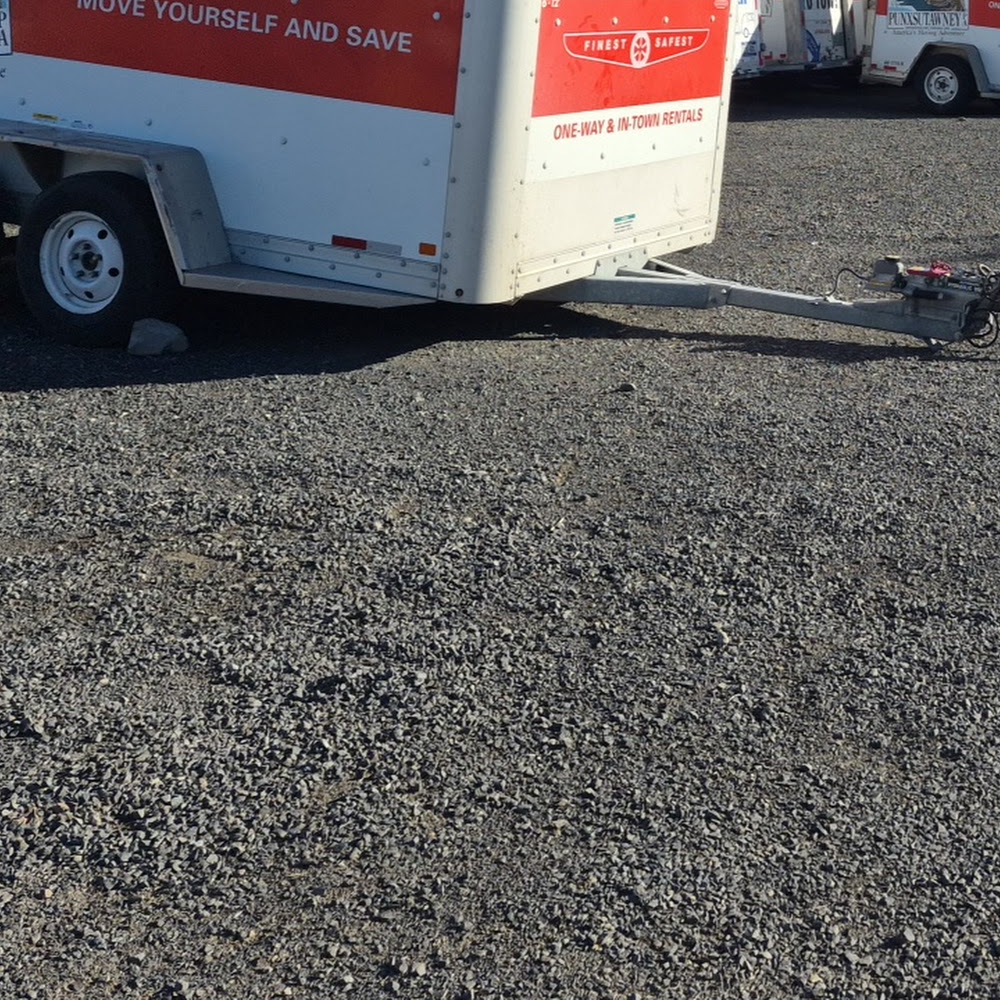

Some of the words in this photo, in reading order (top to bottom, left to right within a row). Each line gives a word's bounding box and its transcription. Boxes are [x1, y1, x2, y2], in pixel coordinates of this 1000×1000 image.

[153, 0, 279, 34] YOURSELF
[284, 17, 340, 43] AND
[345, 26, 413, 54] SAVE
[888, 11, 961, 27] PUNXSUTAWNEY
[583, 38, 628, 52] FINEST
[654, 35, 694, 48] SAFEST
[553, 119, 605, 141] ONE-WAY
[606, 118, 615, 134] &
[617, 113, 660, 132] IN-TOWN
[662, 108, 704, 126] RENTALS
